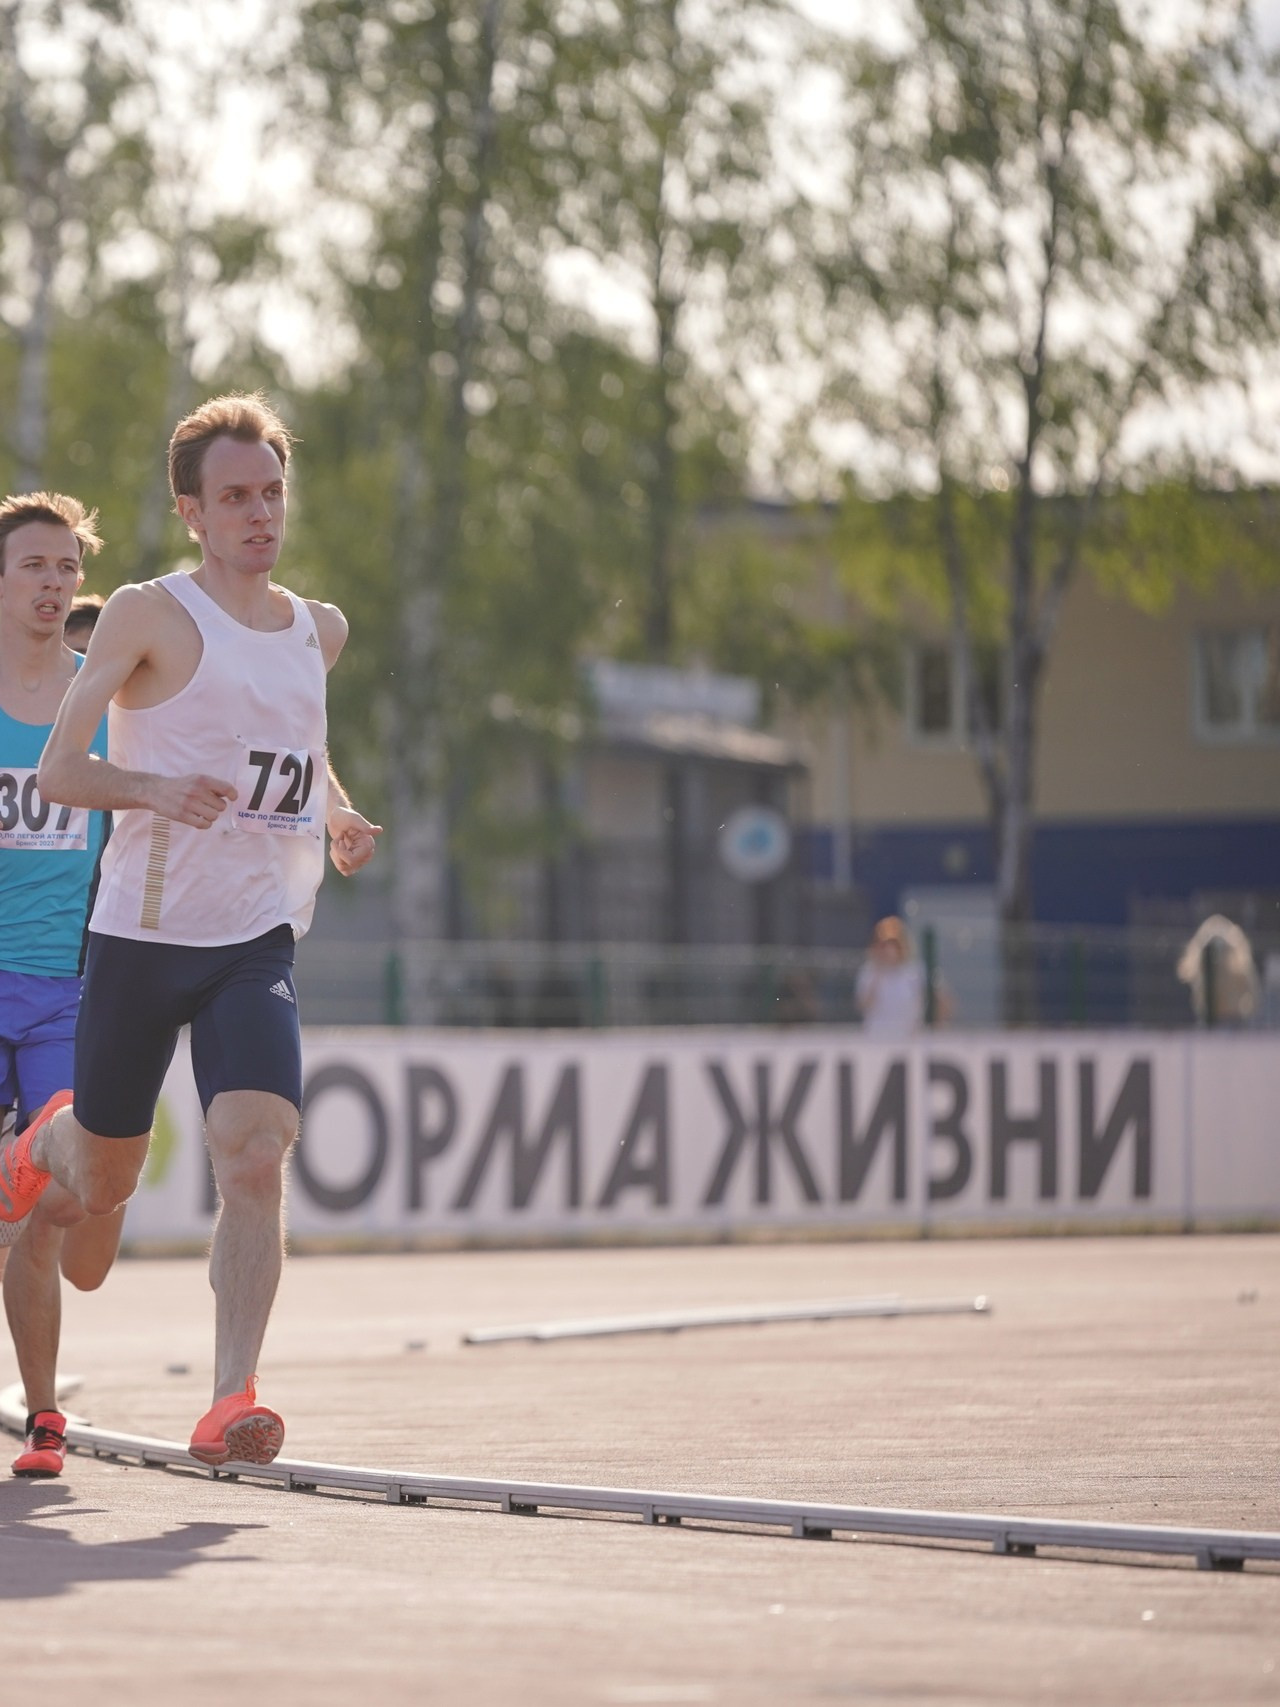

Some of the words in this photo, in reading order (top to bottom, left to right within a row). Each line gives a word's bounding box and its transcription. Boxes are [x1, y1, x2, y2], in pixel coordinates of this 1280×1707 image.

[238, 811, 256, 819] ЦФО
[257, 813, 268, 821] ПО
[268, 814, 296, 823] ЛЕГКОЙ
[4, 832, 15, 840] ПО
[16, 832, 45, 840] ЛЕГКОЙ
[203, 1059, 671, 1213] ОРМА
[702, 1058, 1155, 1206] ЖИЗНИ
